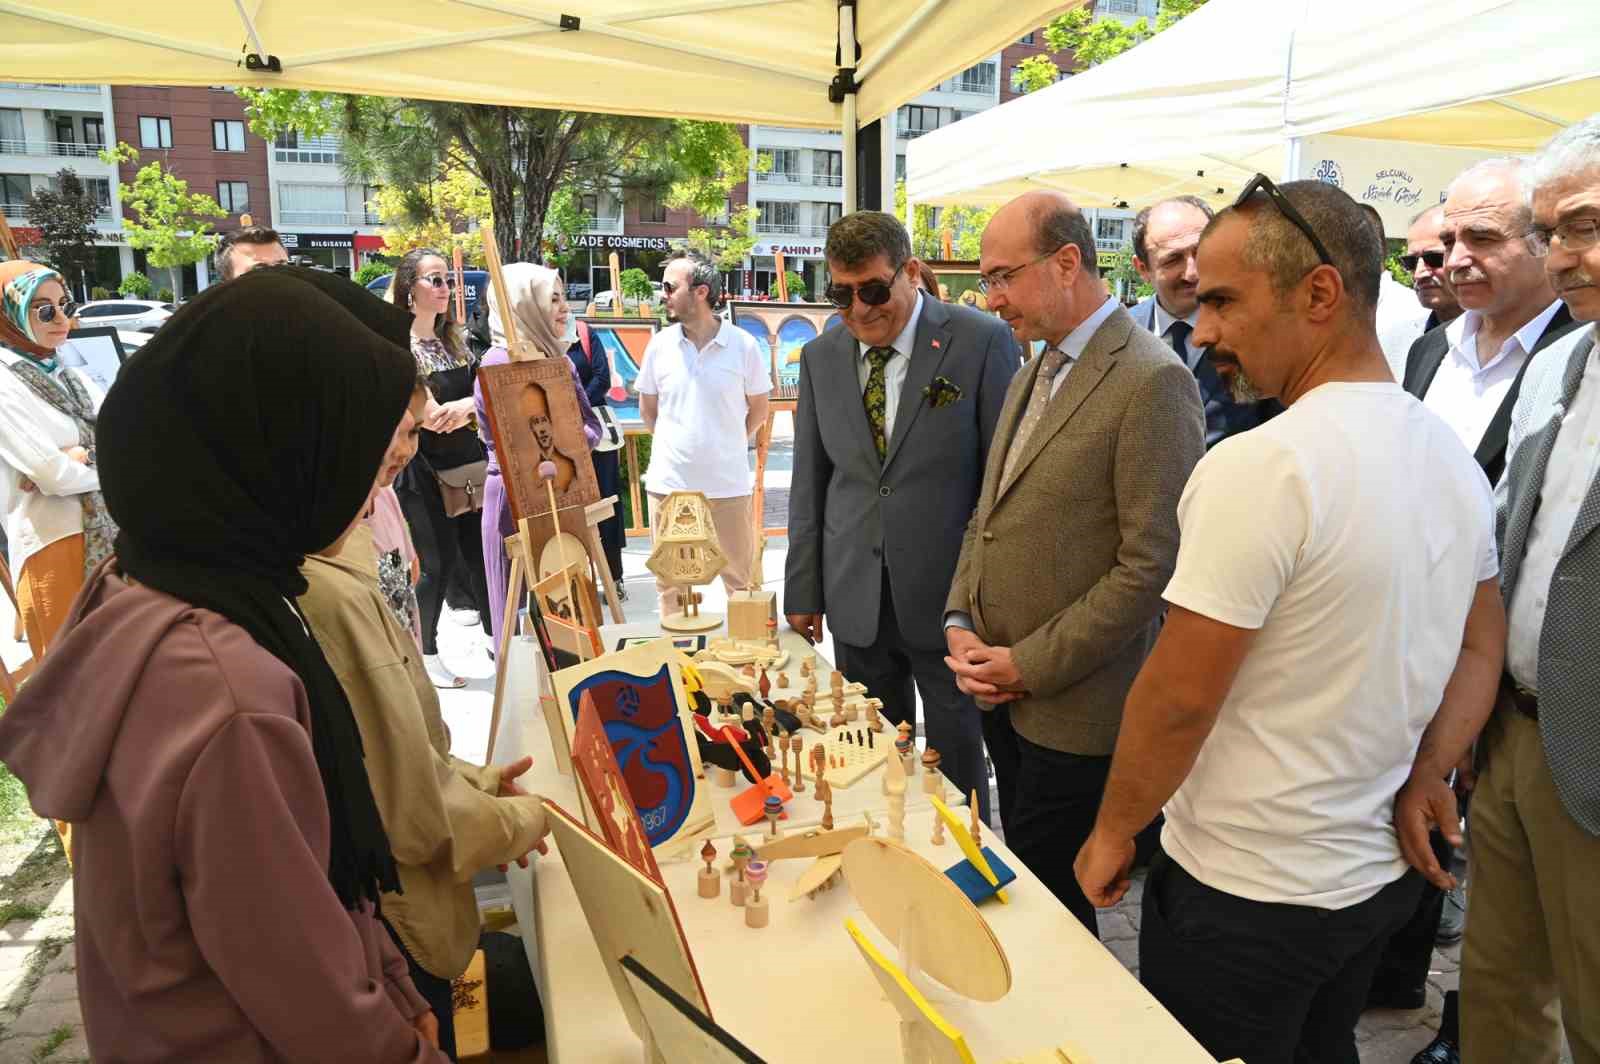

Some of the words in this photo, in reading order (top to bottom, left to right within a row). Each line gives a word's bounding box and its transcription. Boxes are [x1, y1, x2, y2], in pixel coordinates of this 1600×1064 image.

[571, 235, 604, 247] VADE
[607, 236, 665, 249] COSMETICS
[641, 805, 667, 833] 1967
